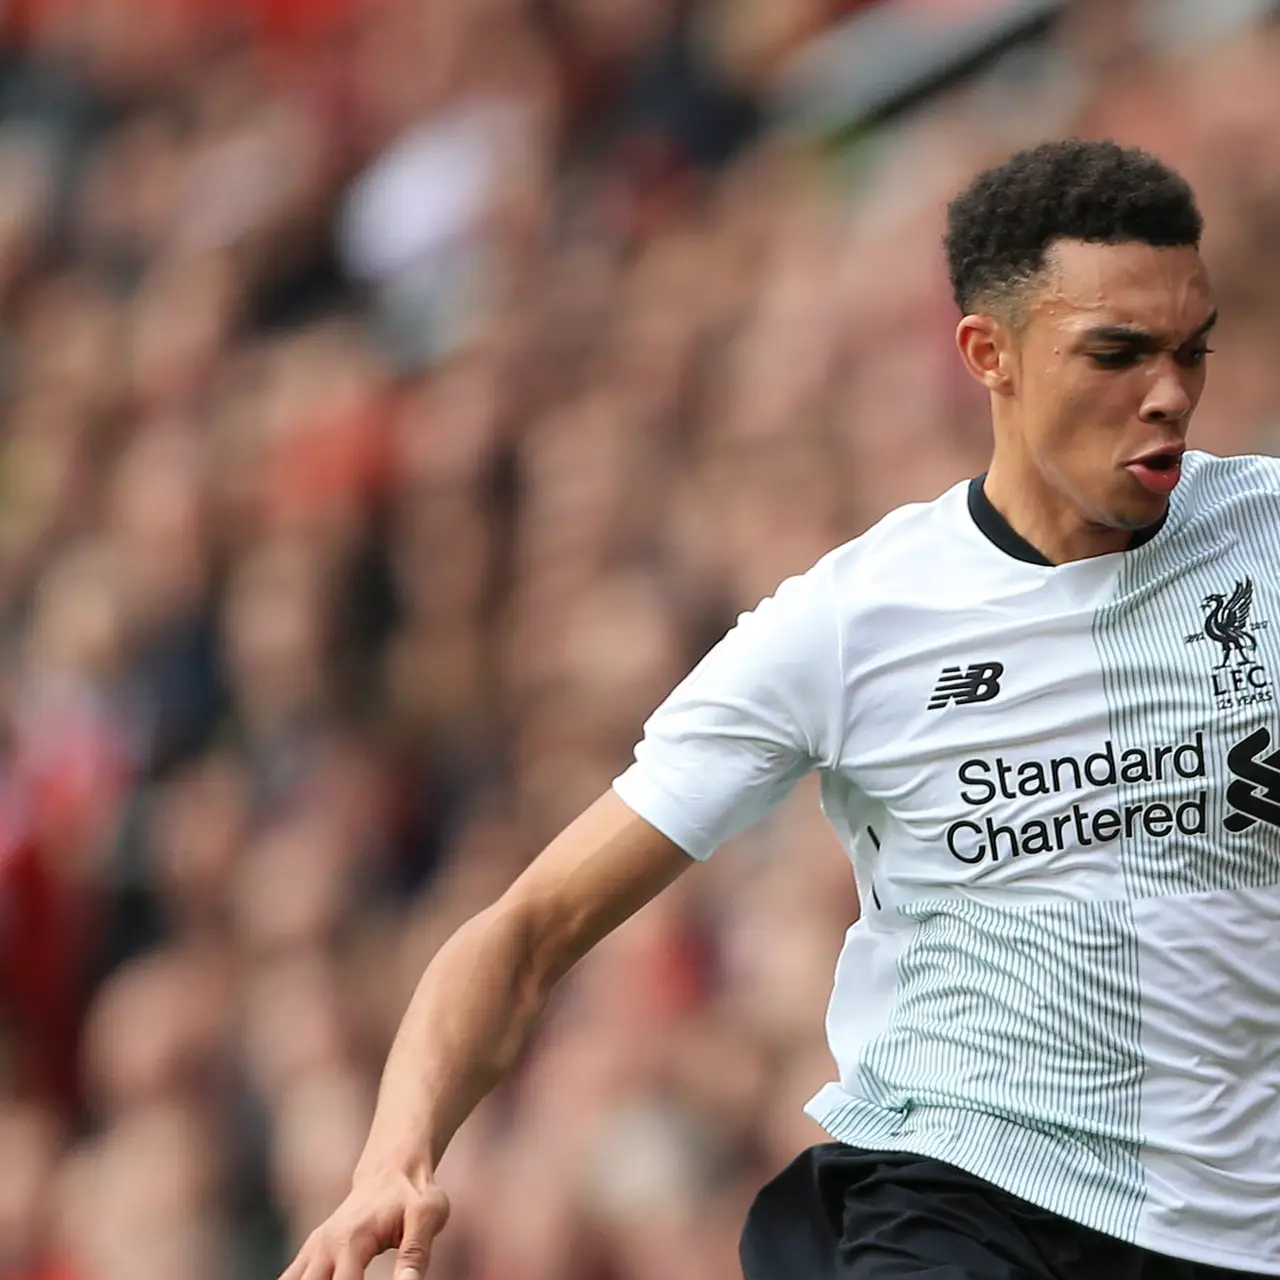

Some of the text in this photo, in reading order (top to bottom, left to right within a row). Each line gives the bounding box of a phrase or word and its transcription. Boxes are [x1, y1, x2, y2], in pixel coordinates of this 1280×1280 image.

[1237, 691, 1272, 706] YEARS
[957, 732, 1206, 806] Standard
[945, 791, 1206, 865] Chartered
